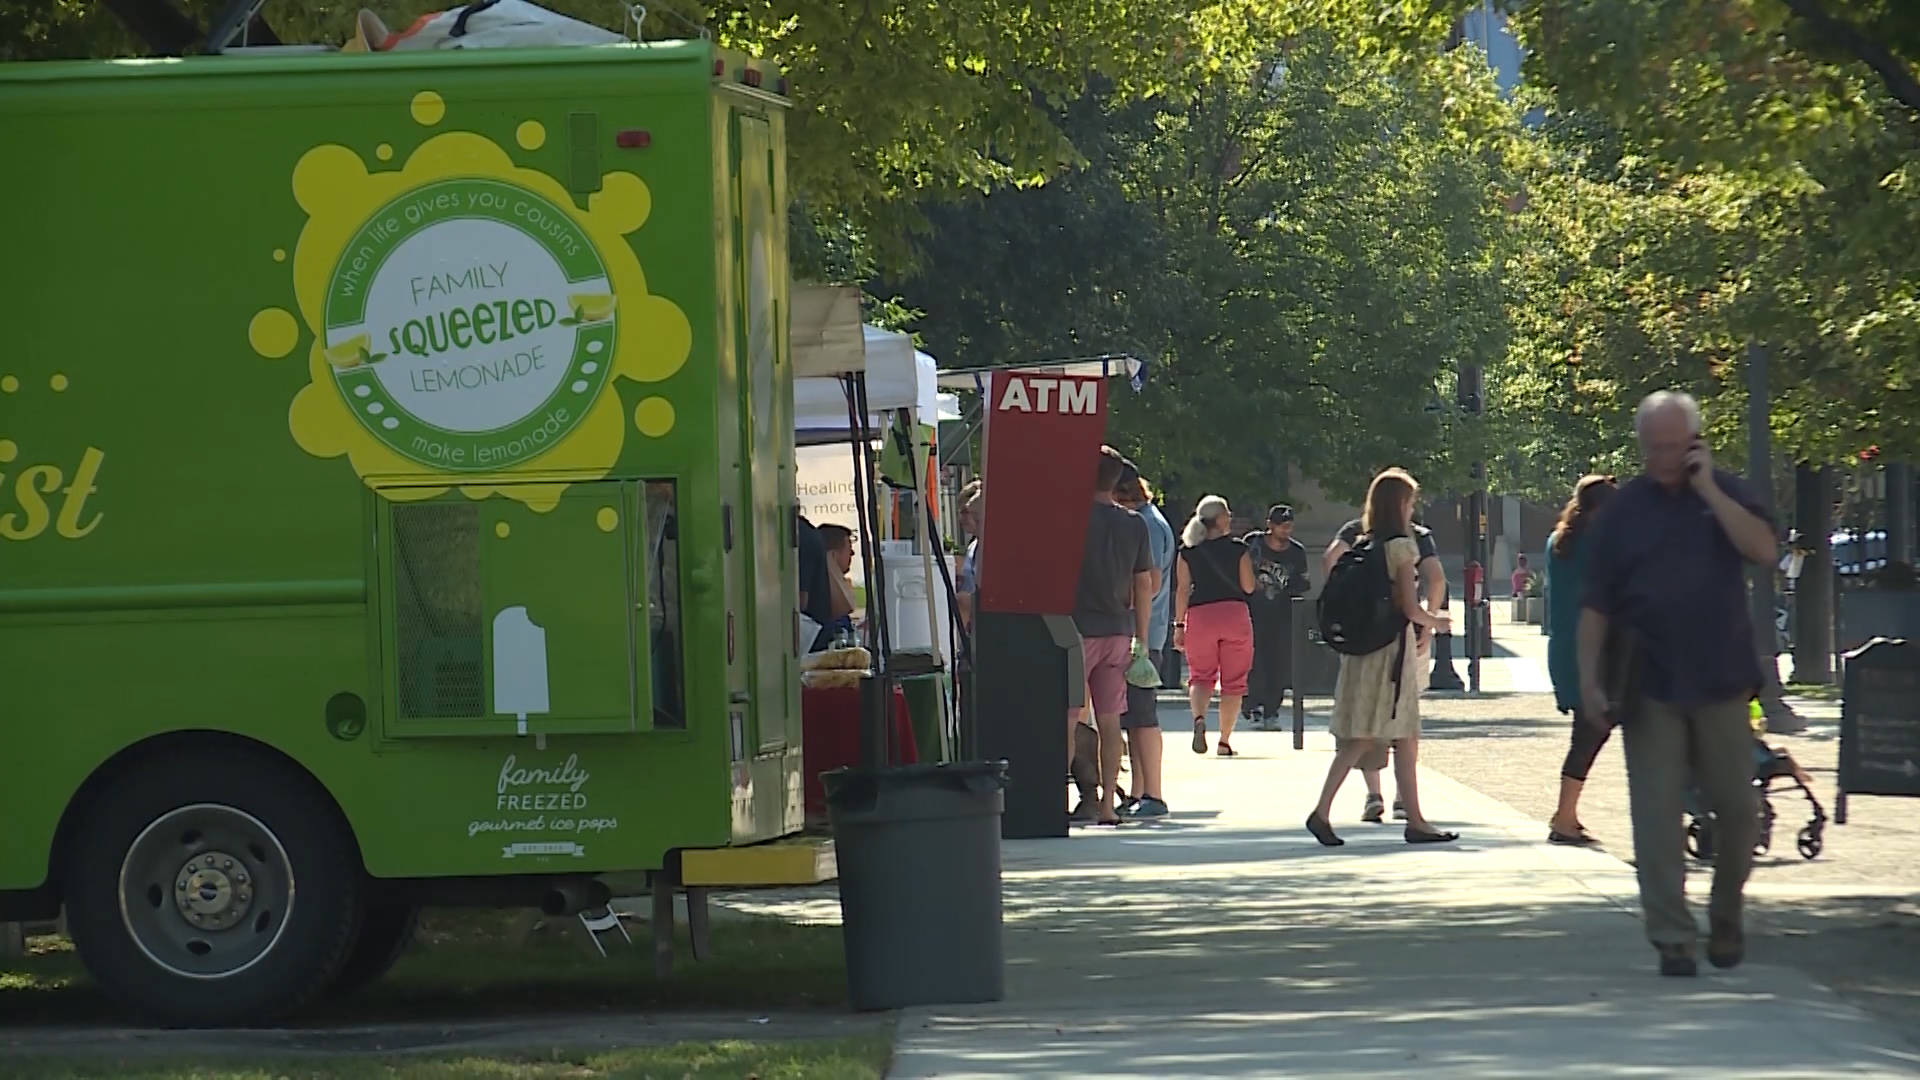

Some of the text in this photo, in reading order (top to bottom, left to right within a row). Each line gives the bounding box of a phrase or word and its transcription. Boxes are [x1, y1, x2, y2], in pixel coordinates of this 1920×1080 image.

[340, 192, 580, 297] when life gives you cousins
[410, 261, 509, 306] FAMILY
[410, 345, 546, 392] LEMONADE
[998, 377, 1099, 415] ATM
[411, 406, 570, 463] make lemonade
[0, 438, 105, 541] st
[814, 502, 857, 515] more
[497, 753, 590, 794] family
[497, 793, 588, 811] FREEZED
[468, 815, 618, 838] gourmet ice pops
